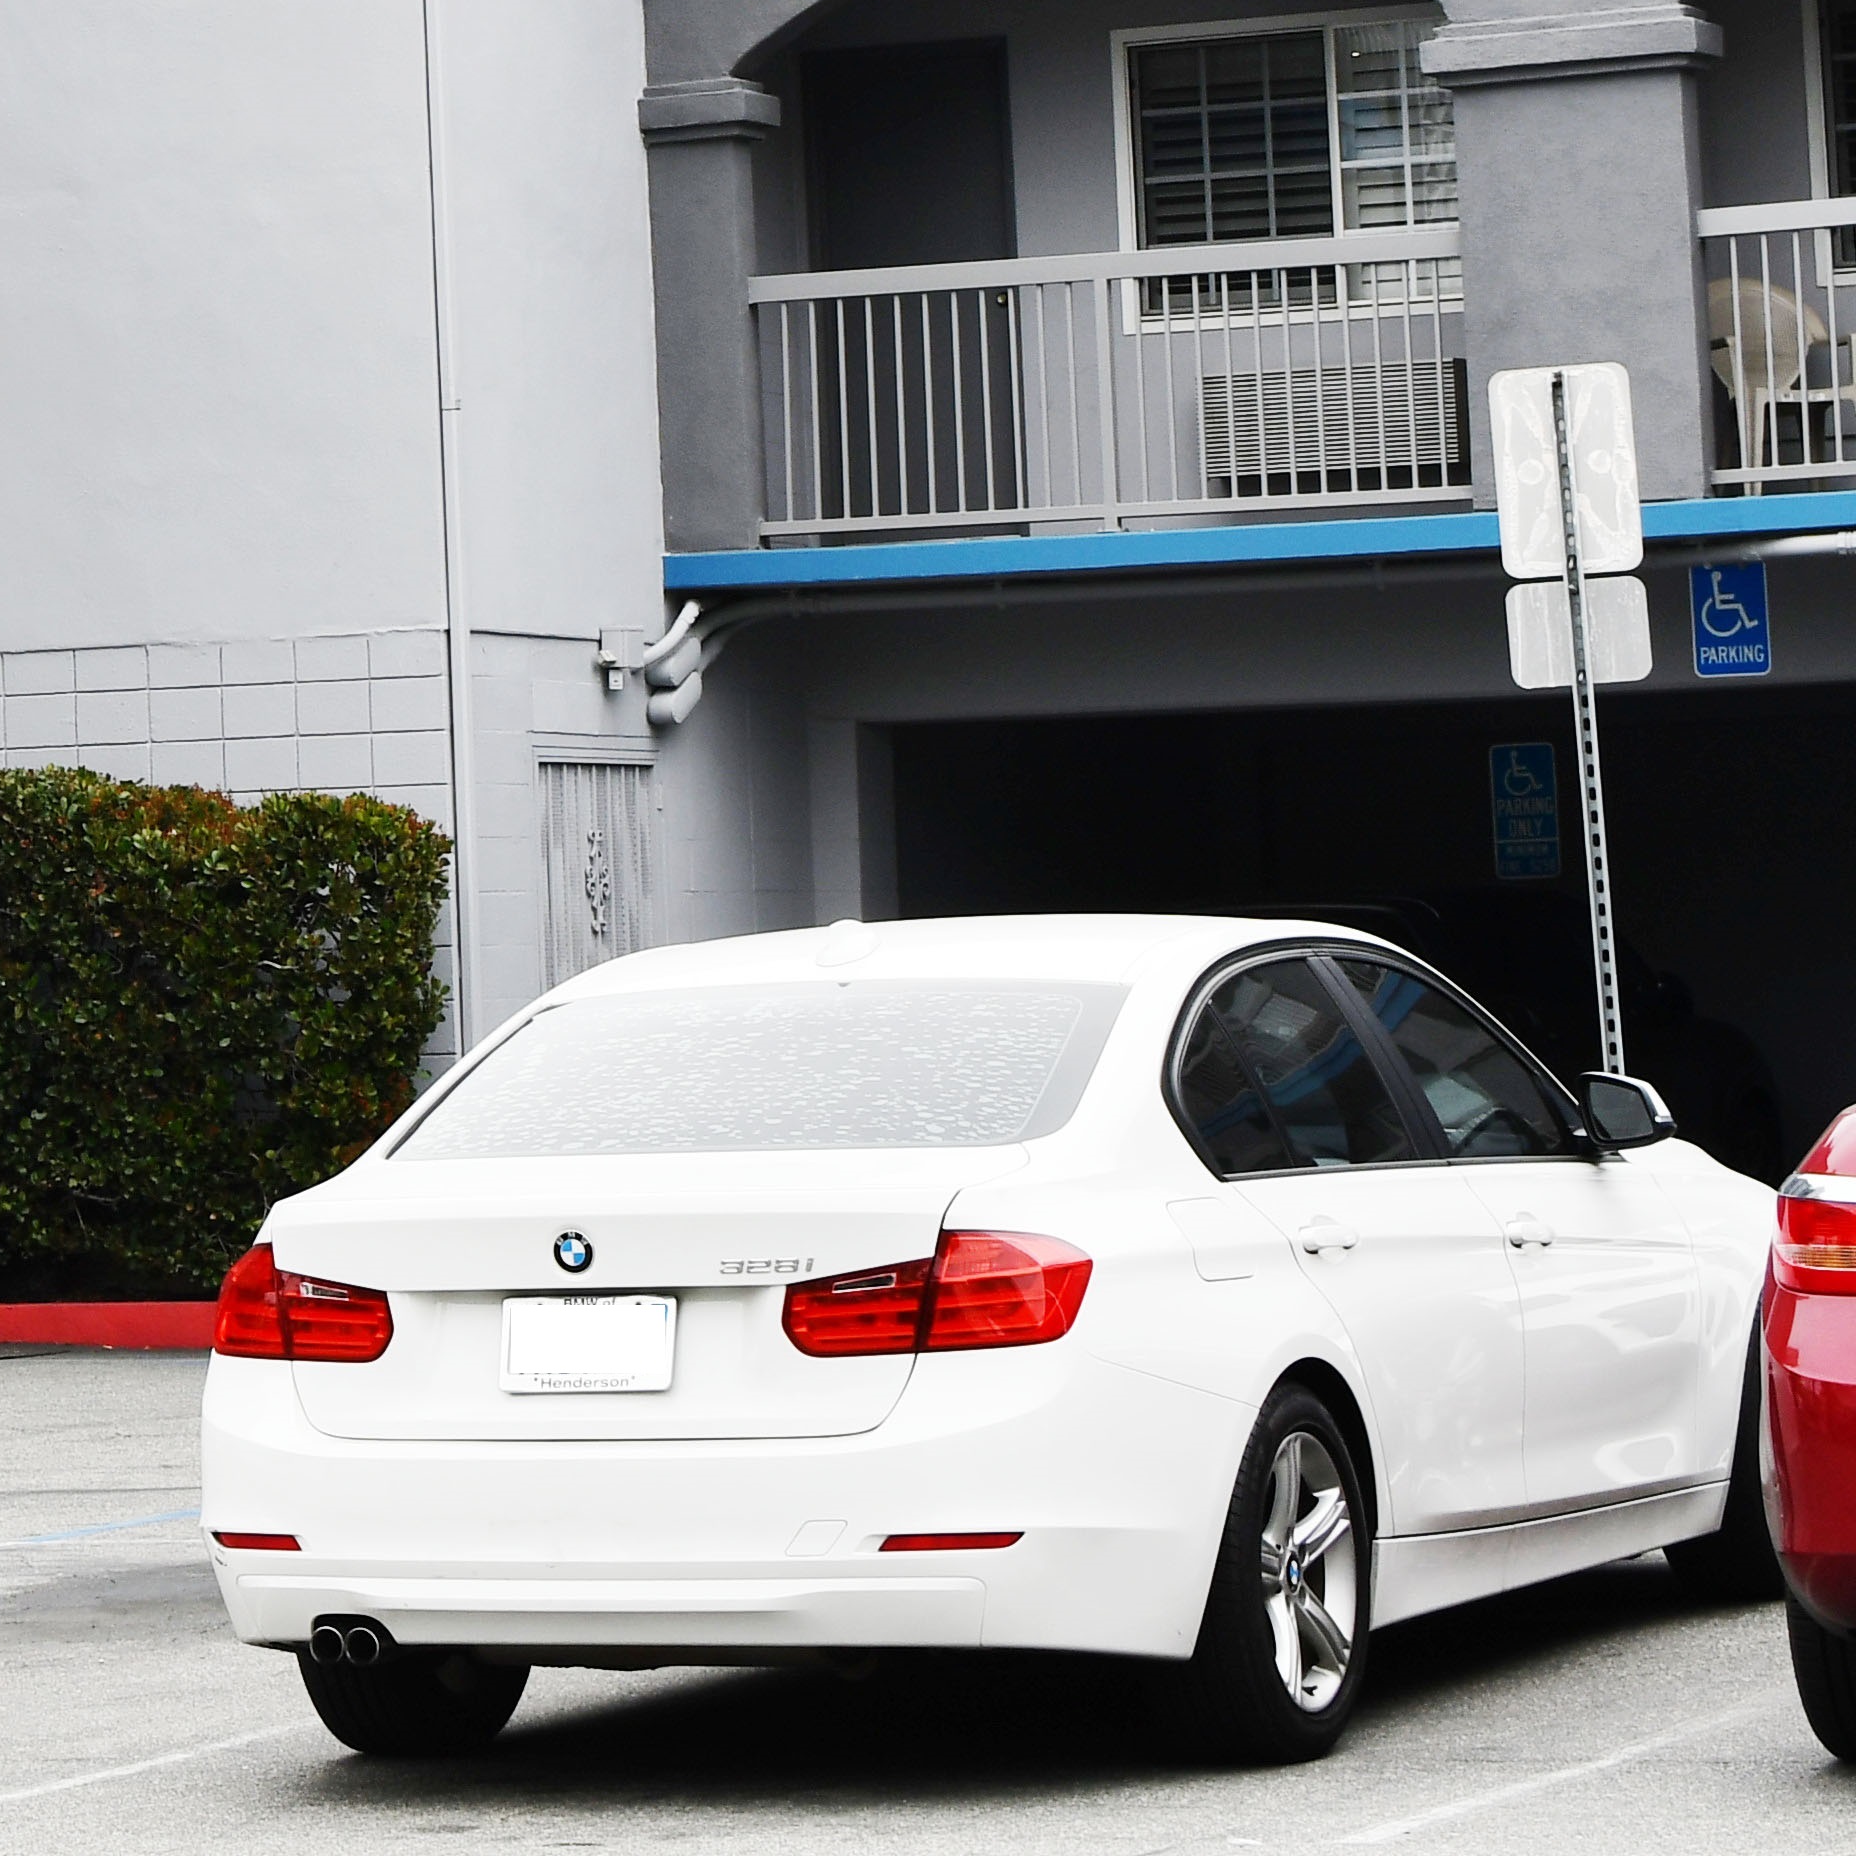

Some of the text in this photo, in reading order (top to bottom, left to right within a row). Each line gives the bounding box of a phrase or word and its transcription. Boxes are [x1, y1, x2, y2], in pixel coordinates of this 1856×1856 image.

[1700, 645, 1765, 664] PARKING
[1496, 796, 1553, 815] PARKING
[1508, 817, 1543, 837] ONLY
[720, 1258, 814, 1274] 328i
[540, 1377, 630, 1389] Henderson
